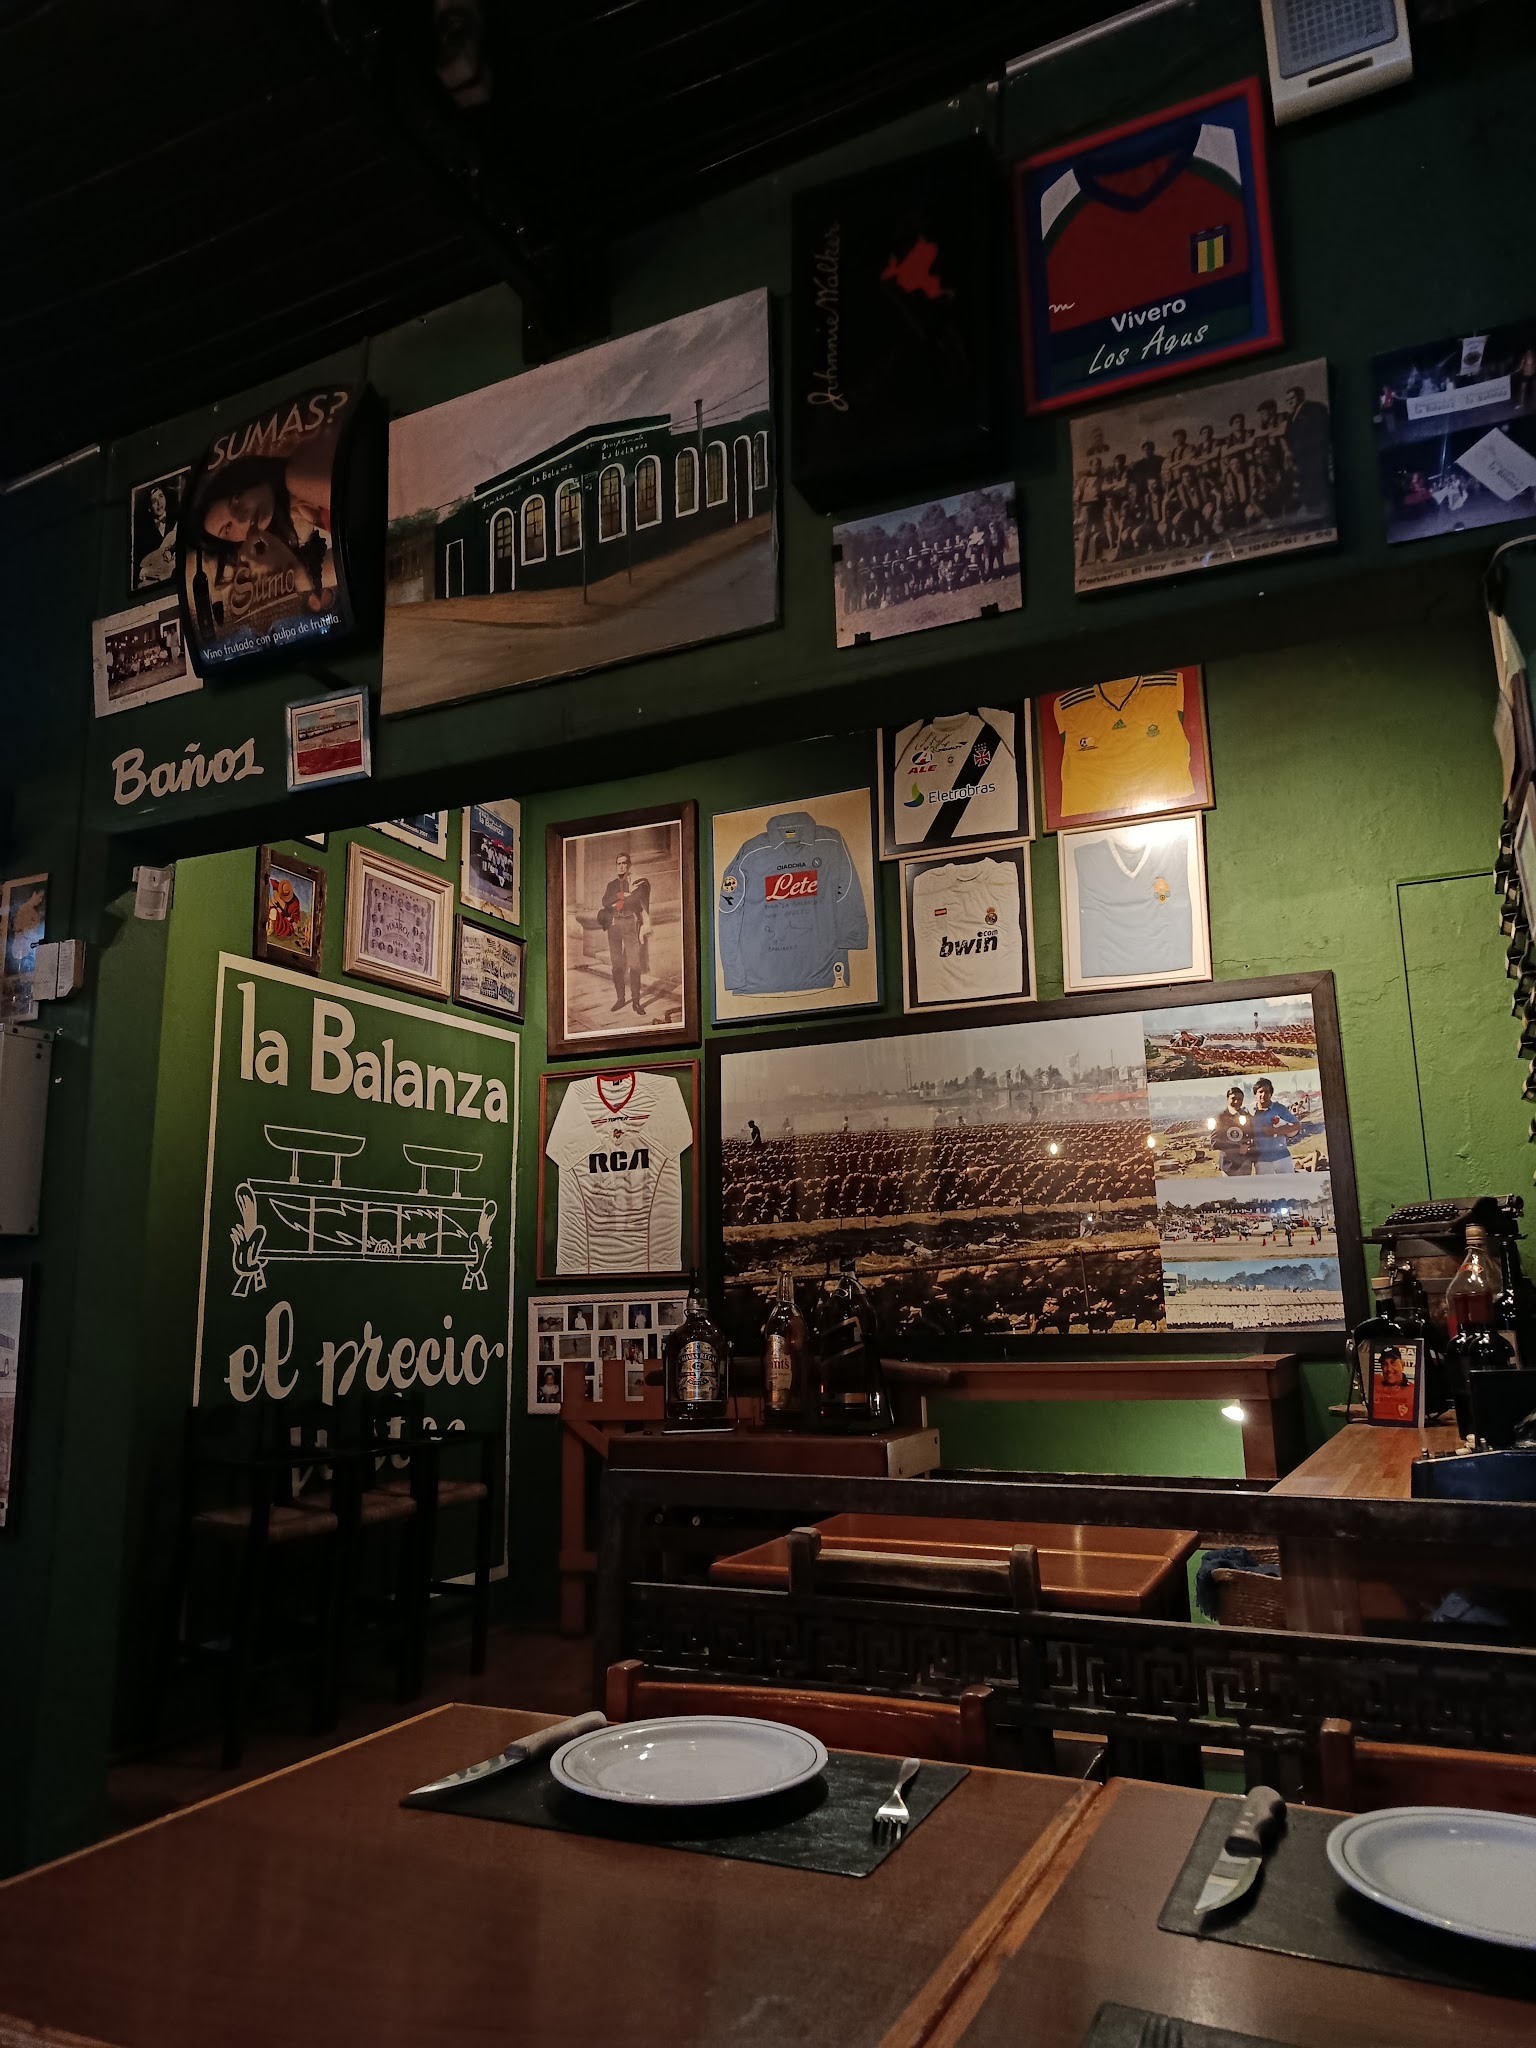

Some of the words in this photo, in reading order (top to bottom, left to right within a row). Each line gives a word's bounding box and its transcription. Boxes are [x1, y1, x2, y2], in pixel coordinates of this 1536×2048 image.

[812, 219, 841, 309] Walker
[1110, 298, 1187, 333] Vivero
[806, 312, 849, 412] Johnnie
[1088, 344, 1130, 375] Los
[1141, 324, 1209, 361] Agus
[207, 391, 349, 471] SUMAS?
[1131, 567, 1142, 576] El
[1171, 558, 1187, 567] de
[230, 566, 296, 616] Sumo
[203, 646, 223, 660] Vino
[224, 638, 254, 657] frutado
[256, 635, 271, 647] con
[273, 626, 297, 644] pulpa
[298, 622, 309, 634] de
[111, 737, 264, 806] Baños
[907, 765, 938, 775] ALE
[928, 783, 996, 803] Eletrobras
[777, 862, 806, 871] DIADORA
[766, 873, 818, 900] Lete
[939, 931, 998, 957] bwin
[237, 981, 289, 1086] la
[310, 997, 508, 1123] Balanza
[589, 1149, 649, 1173] RCA
[224, 1301, 299, 1402] el
[316, 1314, 504, 1407] precio
[700, 1353, 718, 1363] REGAL
